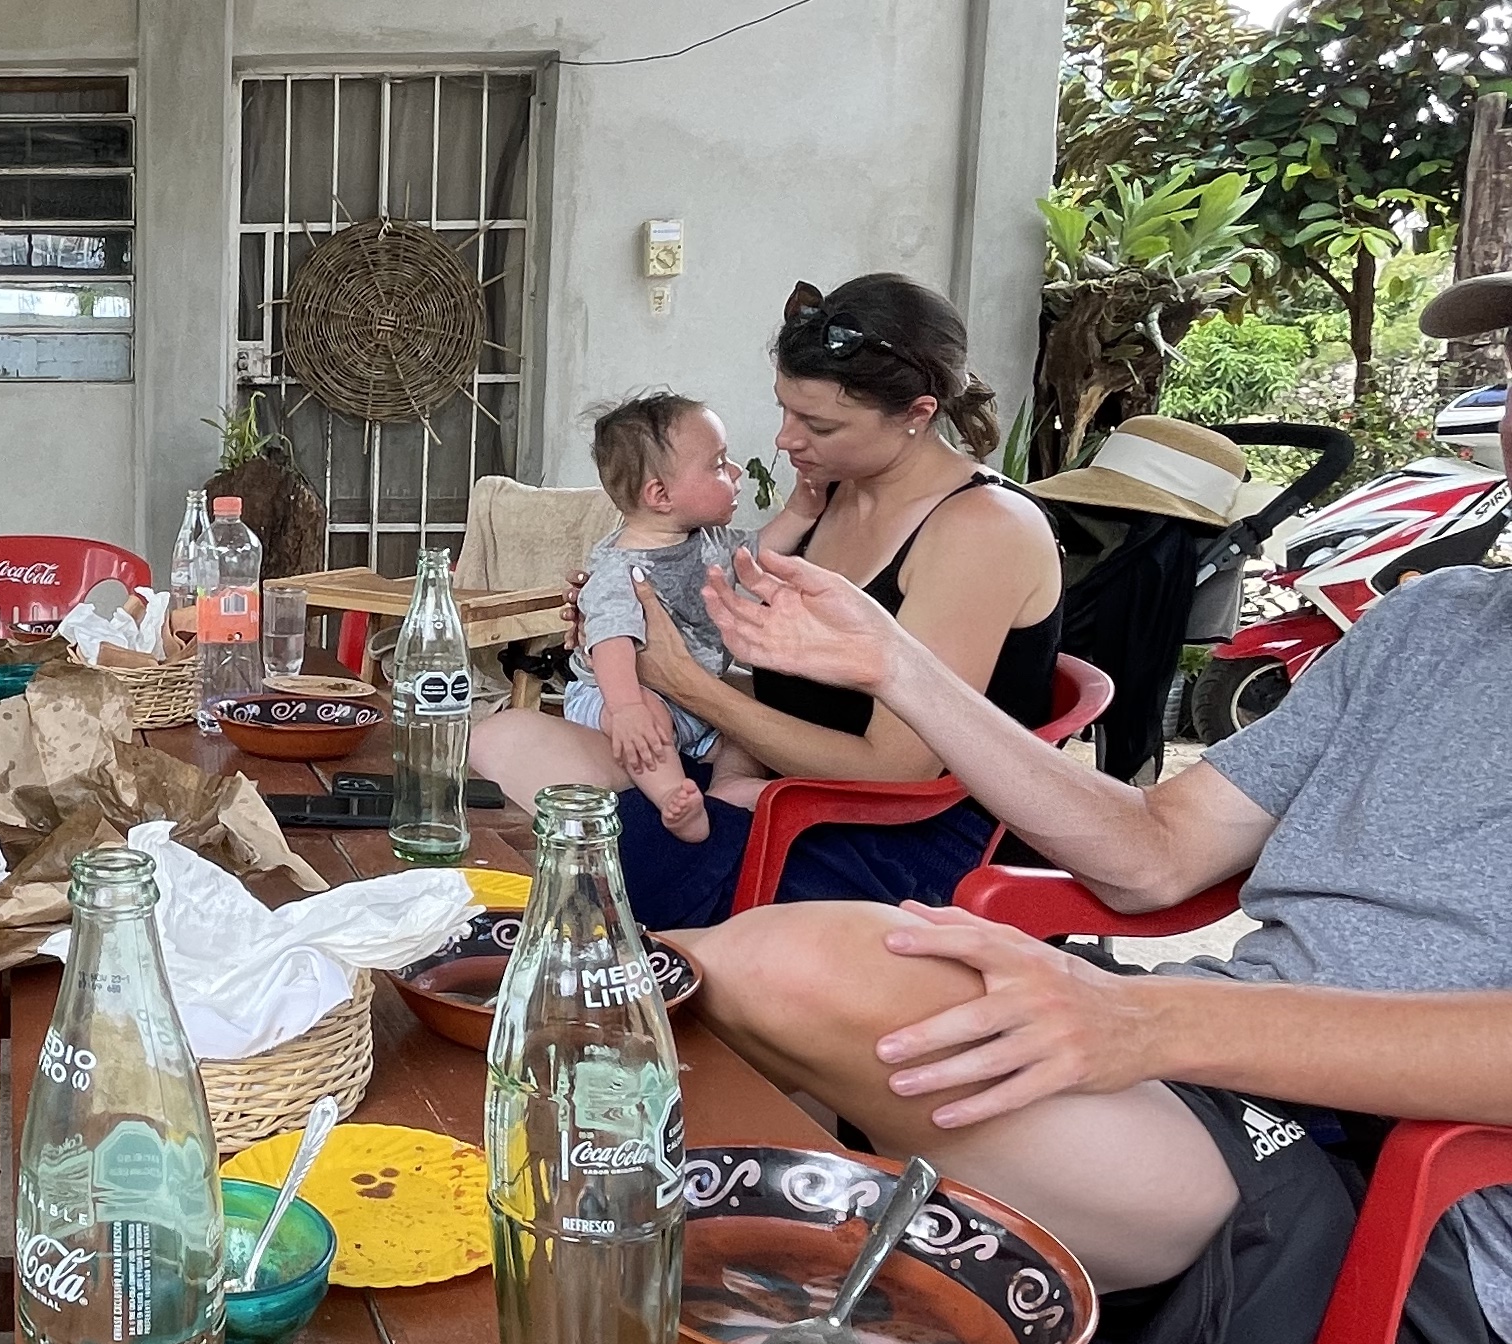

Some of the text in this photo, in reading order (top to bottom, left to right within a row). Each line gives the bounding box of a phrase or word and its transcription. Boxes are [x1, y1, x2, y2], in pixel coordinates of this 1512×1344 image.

[581, 959, 650, 989] MEDI
[584, 975, 654, 1008] LITRO
[44, 1025, 97, 1070] EDIO
[570, 1138, 649, 1168] Coca-Cola
[112, 1221, 123, 1257] REFRESCO
[562, 1216, 615, 1234] REFRESCO
[112, 1258, 123, 1278] PARA
